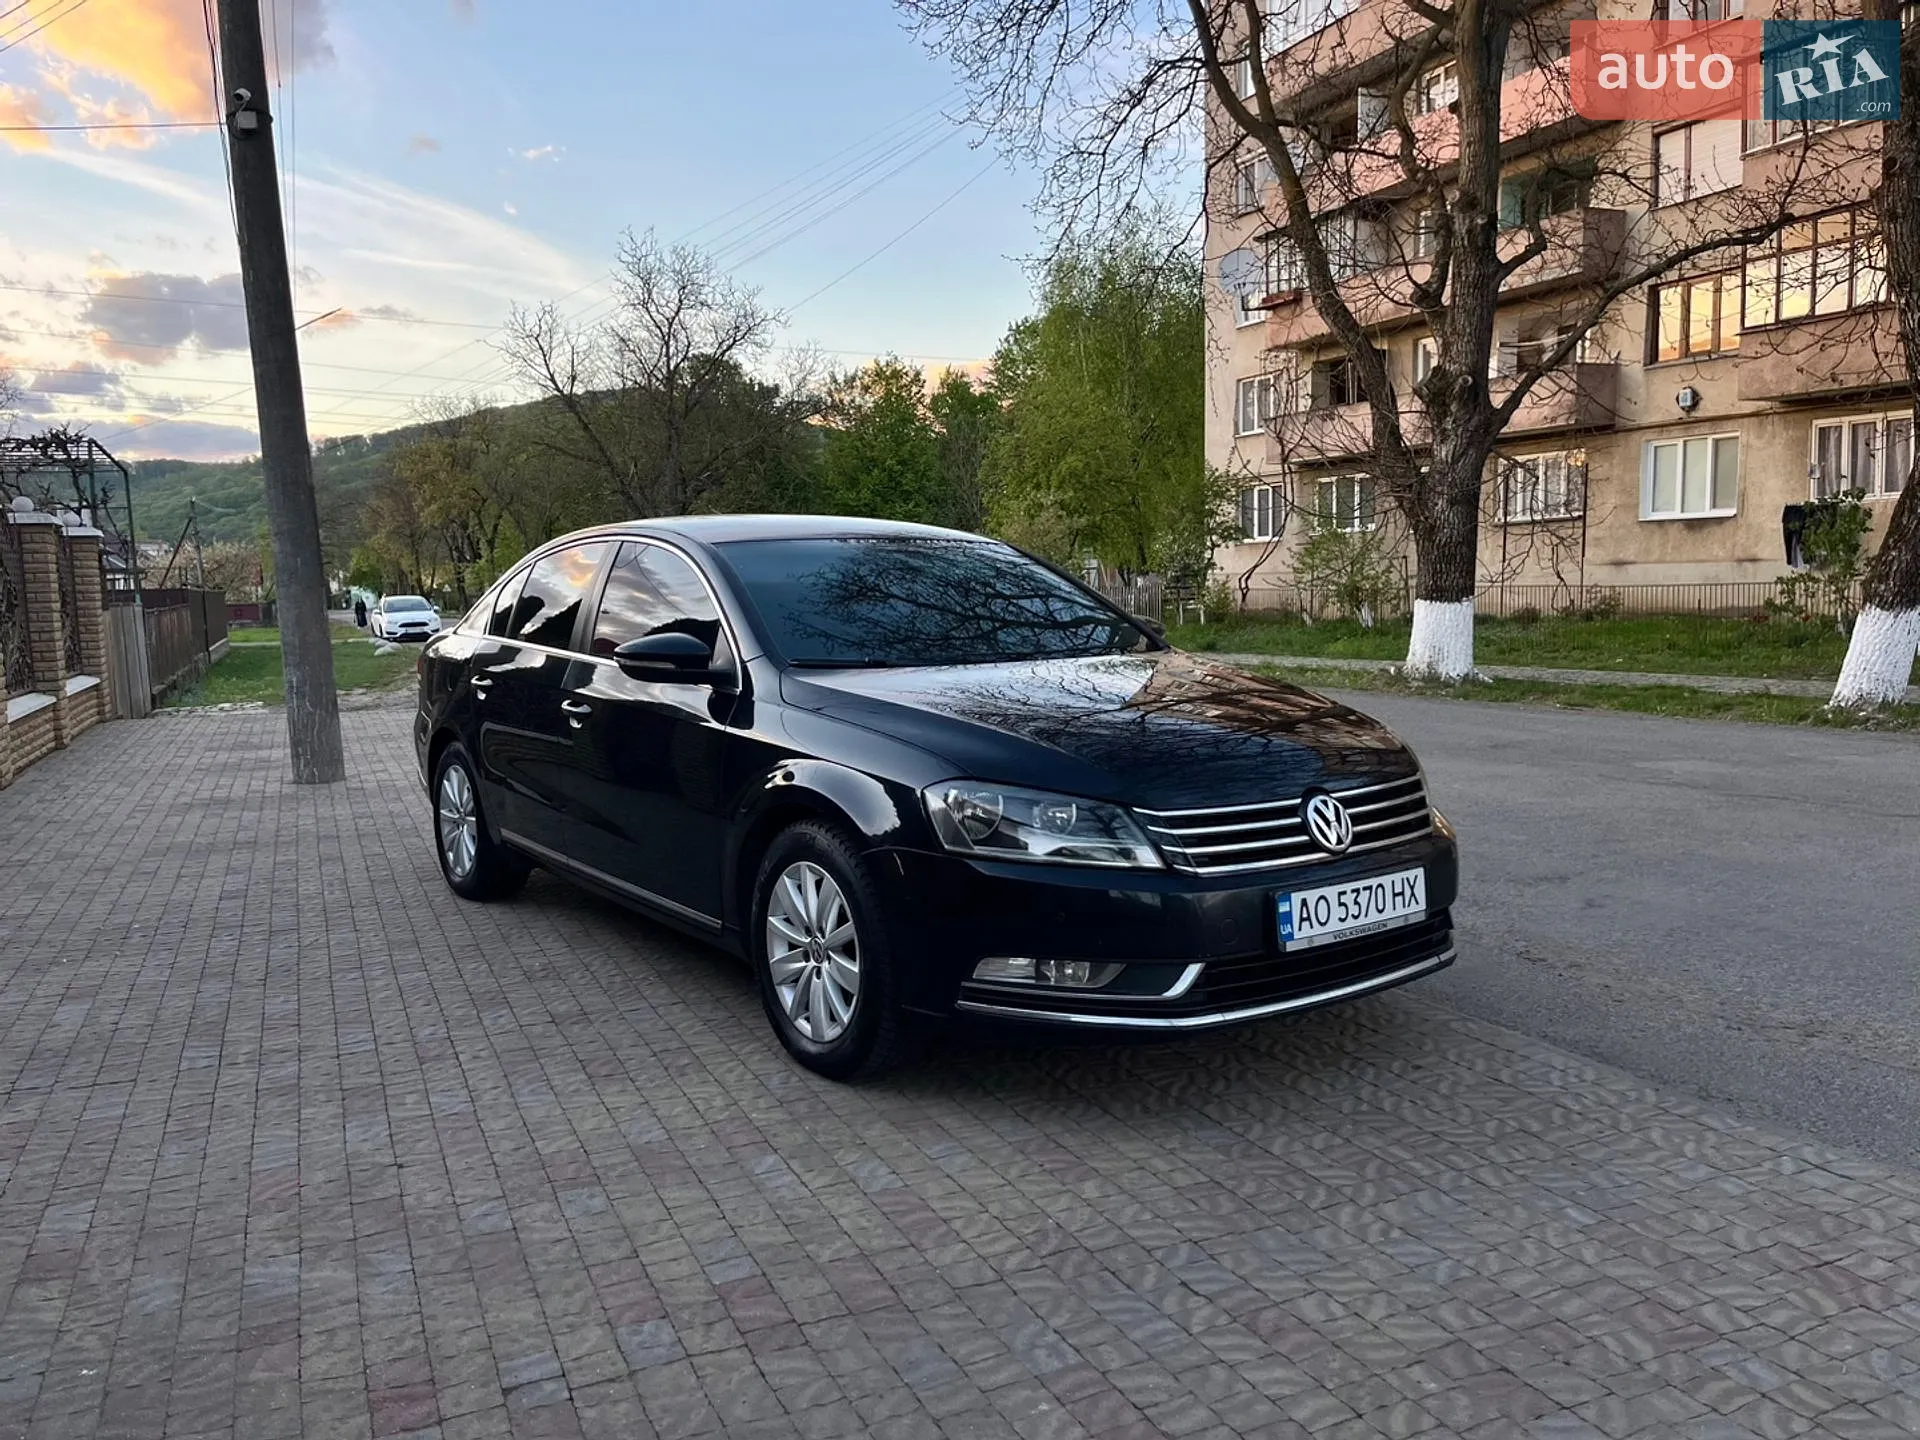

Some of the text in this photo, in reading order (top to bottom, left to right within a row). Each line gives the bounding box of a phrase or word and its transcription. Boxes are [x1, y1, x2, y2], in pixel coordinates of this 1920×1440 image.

[1298, 875, 1419, 931] AO 5370 HX
[1280, 923, 1292, 935] UA
[1332, 922, 1388, 940] VOLKSWAGEN
